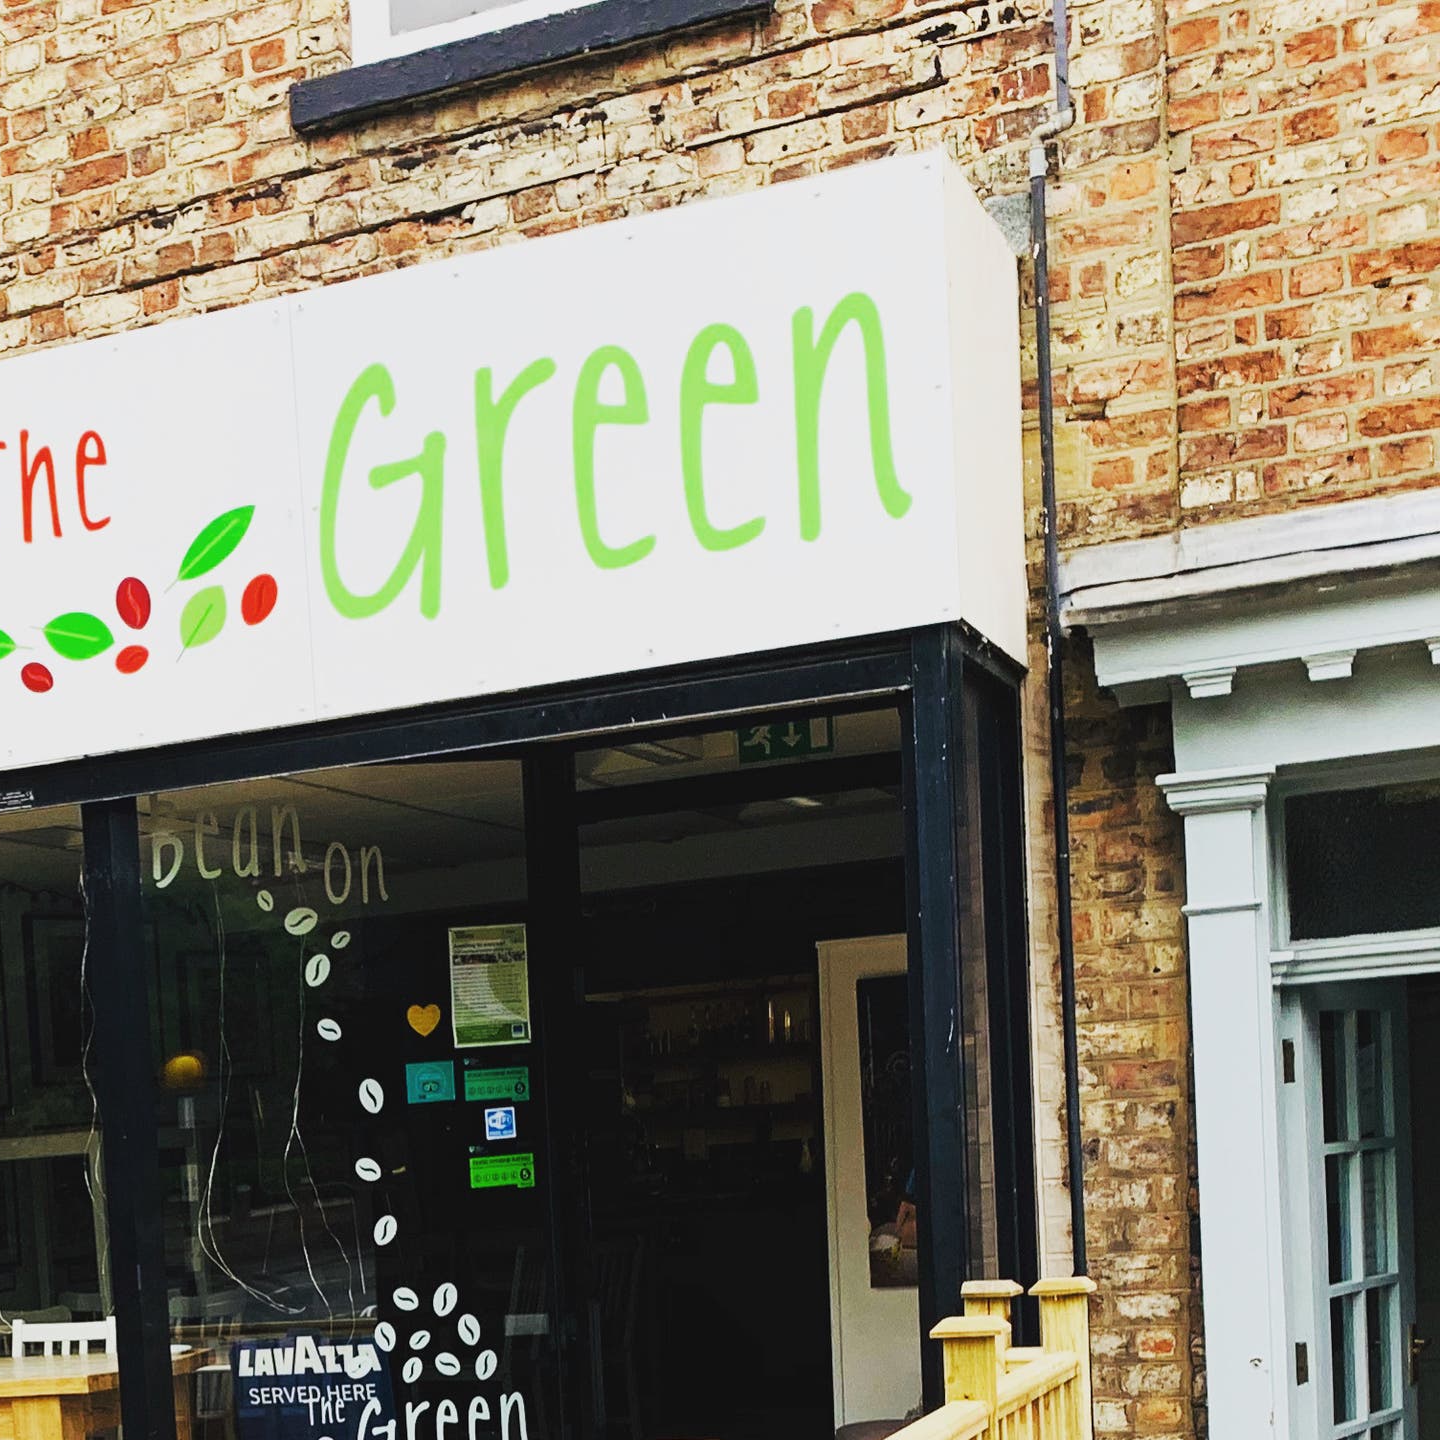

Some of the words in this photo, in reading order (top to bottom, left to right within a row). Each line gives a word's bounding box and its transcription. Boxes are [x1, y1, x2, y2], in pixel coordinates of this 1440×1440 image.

[319, 291, 912, 620] Green
[248, 1385, 321, 1406] SERVED
[326, 1383, 377, 1402] HERE
[301, 1395, 346, 1427] The
